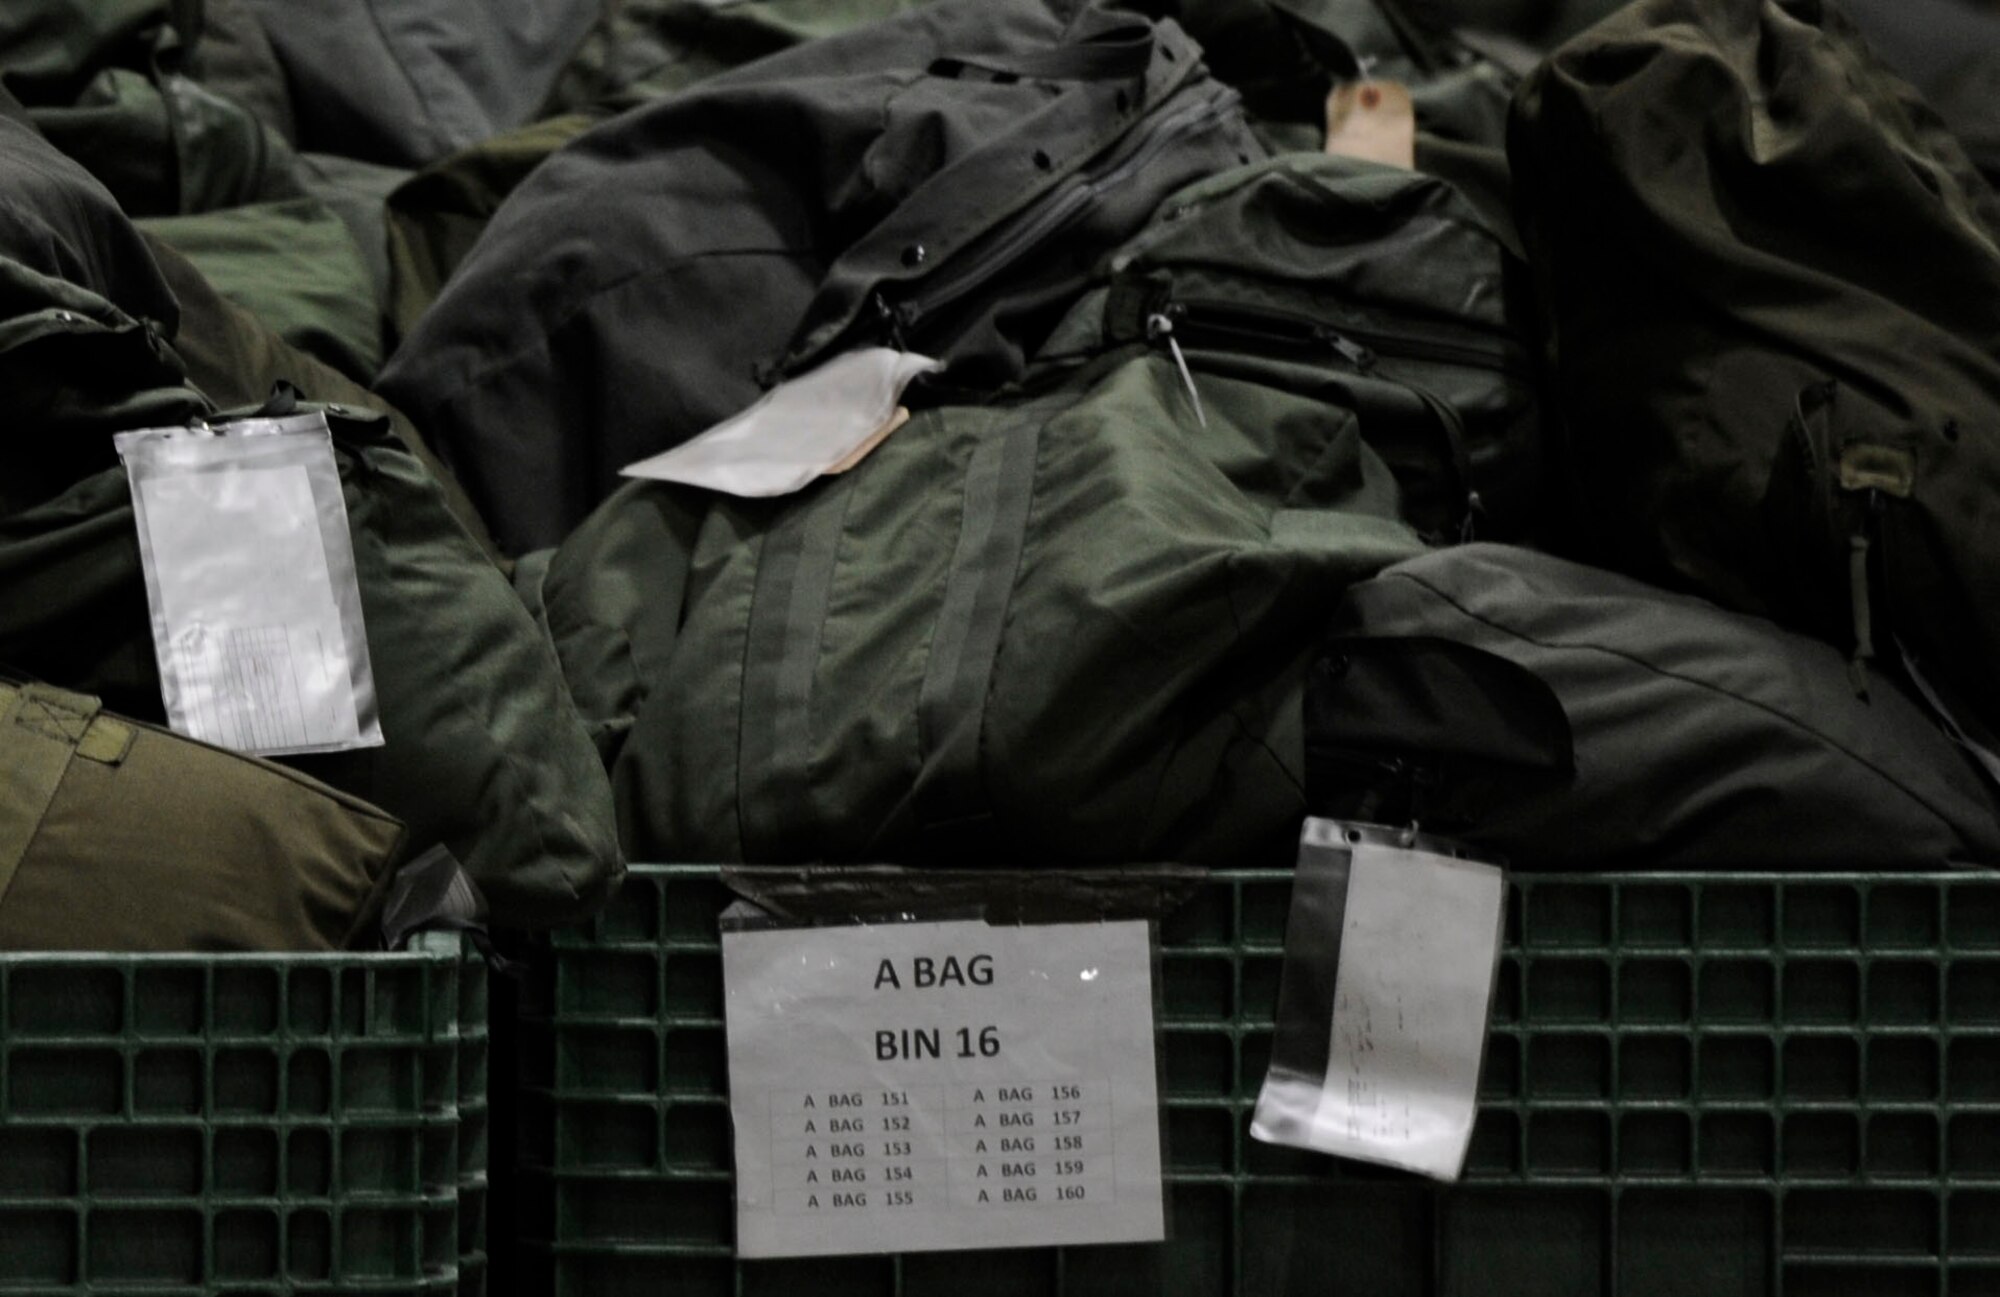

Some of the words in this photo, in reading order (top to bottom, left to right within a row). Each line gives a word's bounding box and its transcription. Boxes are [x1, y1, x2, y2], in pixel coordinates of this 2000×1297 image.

[873, 958, 901, 990] A
[913, 953, 994, 989] BAG
[875, 1027, 941, 1062] BIN
[956, 1025, 1001, 1059] 16
[803, 1094, 815, 1108] A
[828, 1093, 863, 1108] BAG
[882, 1092, 909, 1106] 151
[973, 1089, 985, 1102] A
[998, 1087, 1033, 1102] BAG
[1052, 1086, 1081, 1100] 156
[804, 1119, 816, 1133] A
[829, 1119, 864, 1133] BAG
[883, 1116, 910, 1131] 152
[974, 1113, 986, 1128] A
[999, 1112, 1034, 1127] BAG
[1054, 1110, 1081, 1126] 157
[806, 1144, 817, 1158] A
[830, 1143, 865, 1158] BAG
[884, 1141, 912, 1156] 153
[975, 1139, 987, 1153] A
[1000, 1137, 1035, 1152] BAG
[1054, 1135, 1083, 1150] 158
[806, 1169, 818, 1183] A
[831, 1168, 866, 1183] BAG
[885, 1166, 913, 1181] 154
[976, 1164, 988, 1177] A
[1001, 1162, 1036, 1177] BAG
[1055, 1160, 1084, 1175] 159
[807, 1194, 819, 1208] A
[832, 1193, 867, 1208] BAG
[886, 1191, 914, 1206] 155
[978, 1189, 990, 1203] A
[1002, 1188, 1037, 1202] BAG
[1057, 1185, 1085, 1201] 160
